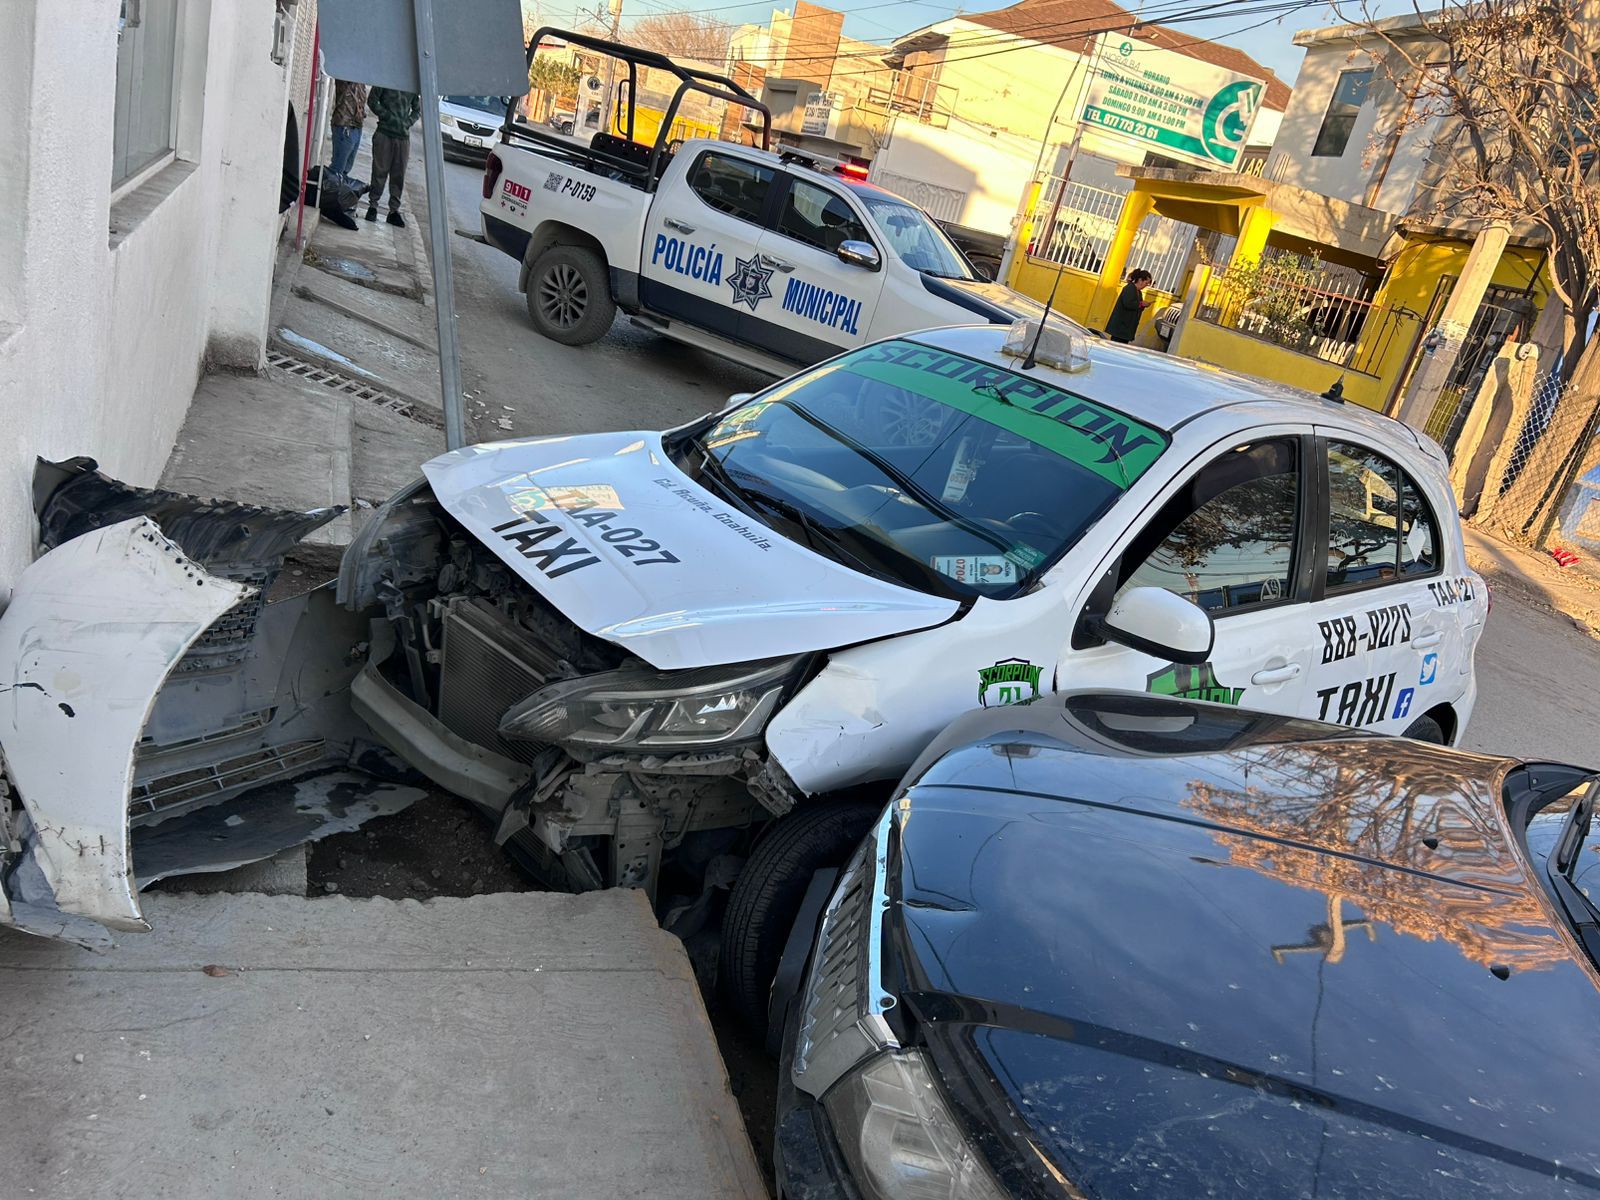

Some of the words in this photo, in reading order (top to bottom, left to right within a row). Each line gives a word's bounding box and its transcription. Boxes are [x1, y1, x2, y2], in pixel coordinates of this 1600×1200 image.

[1143, 69, 1170, 85] HORARIO
[1102, 96, 1131, 112] DOMINGO
[1146, 110, 1158, 120] AM
[1175, 118, 1186, 129] PM
[1147, 97, 1158, 108] AM
[1103, 113, 1120, 127] 877
[1119, 117, 1135, 132] 773
[1134, 122, 1147, 136] 23
[1146, 126, 1159, 140] 61
[503, 179, 532, 201] 911
[560, 177, 597, 203] P-0159
[652, 233, 723, 286] POLICÍA
[781, 277, 863, 335] MUNICIPAL
[850, 344, 1160, 464] SCORPION
[491, 509, 602, 580] TAXI
[1316, 602, 1412, 665] 888-9275
[978, 663, 1045, 702] SCORPION
[1316, 671, 1397, 727] TAXI
